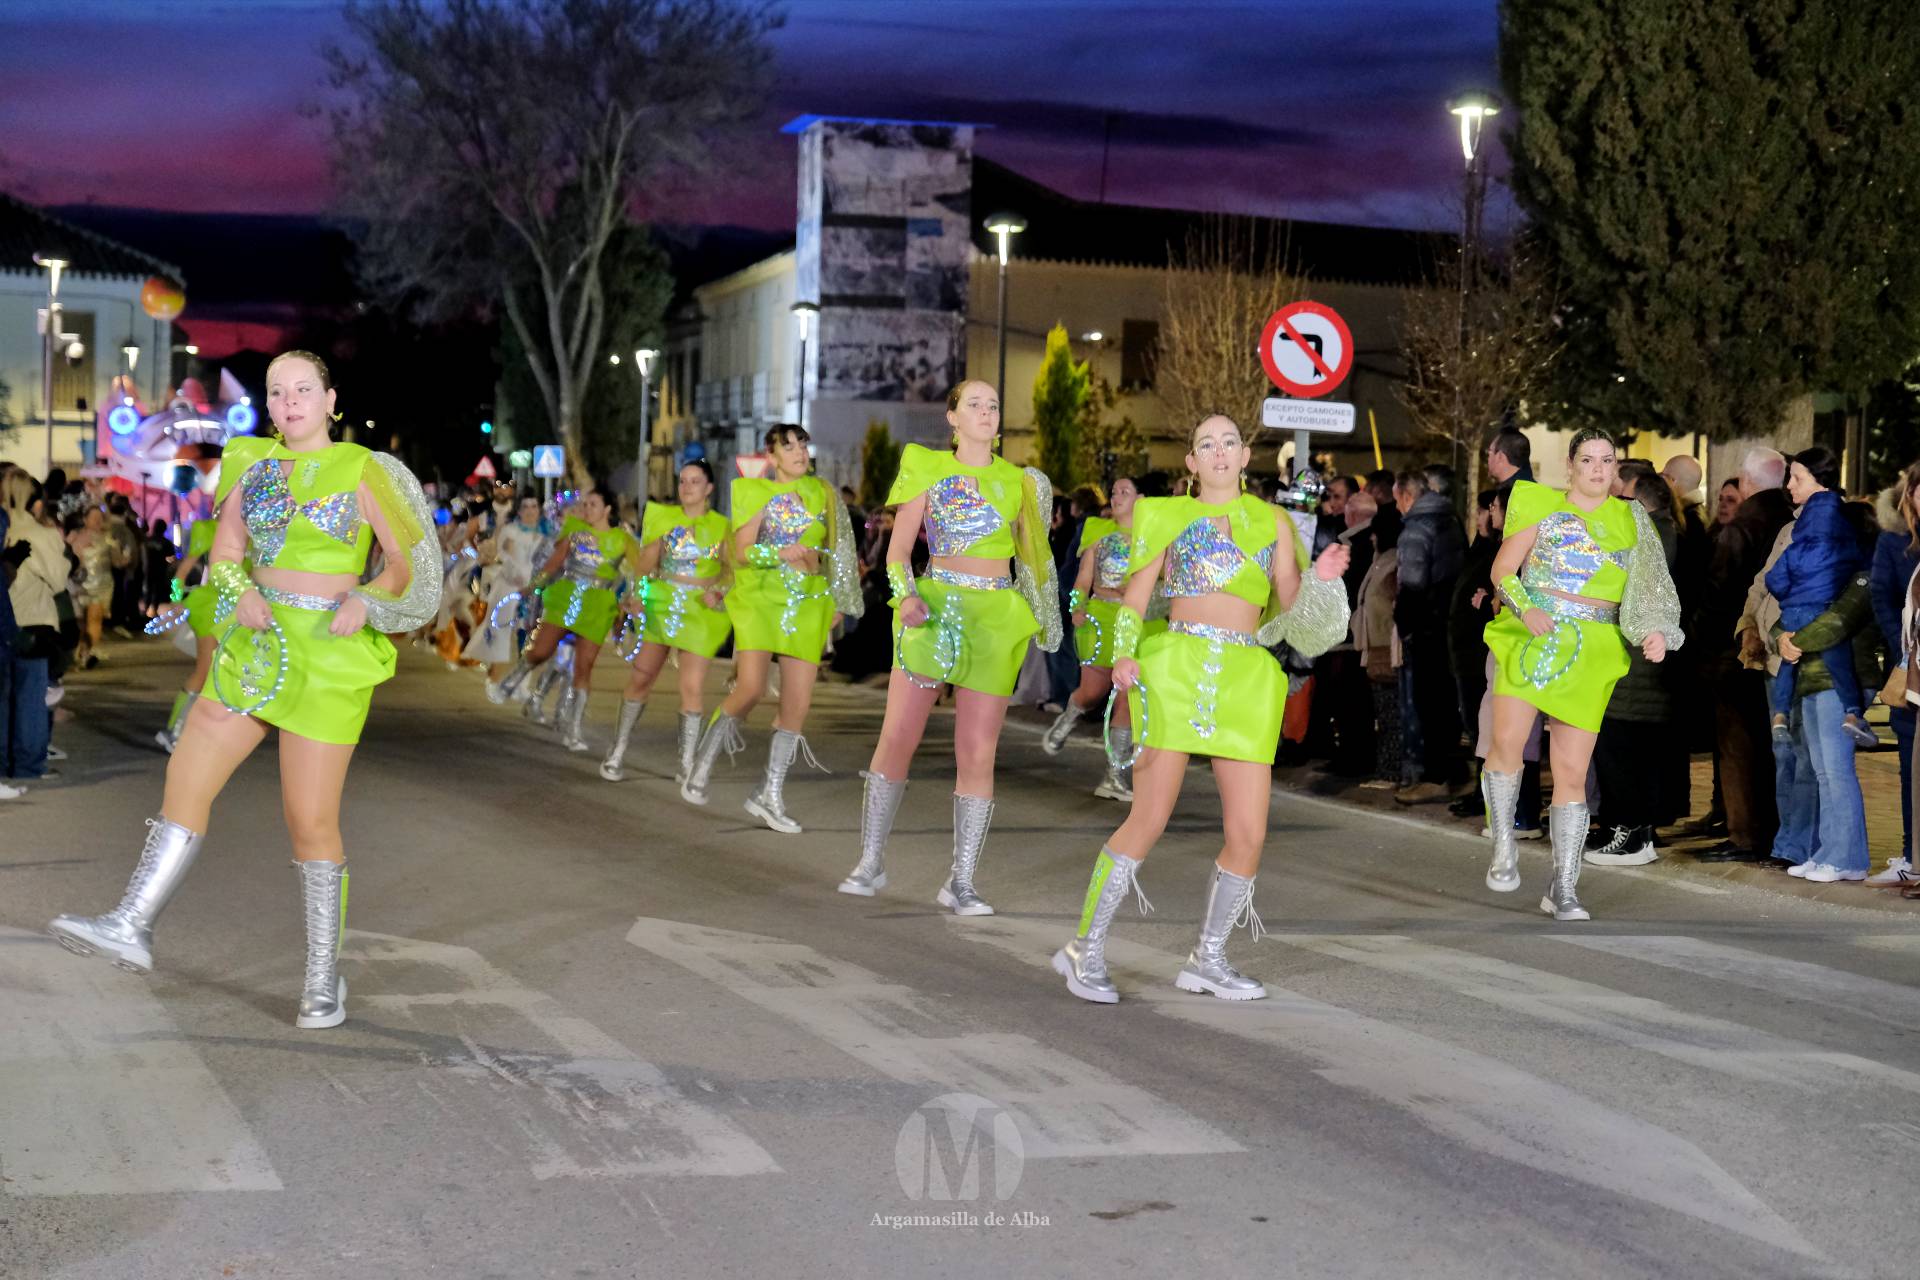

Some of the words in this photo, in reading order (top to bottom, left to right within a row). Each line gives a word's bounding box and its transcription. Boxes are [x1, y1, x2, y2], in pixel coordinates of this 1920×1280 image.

[1265, 403, 1305, 413] EXCEPTO
[1306, 406, 1352, 416] CAMIONES
[1286, 415, 1338, 426] AUTOBUSES
